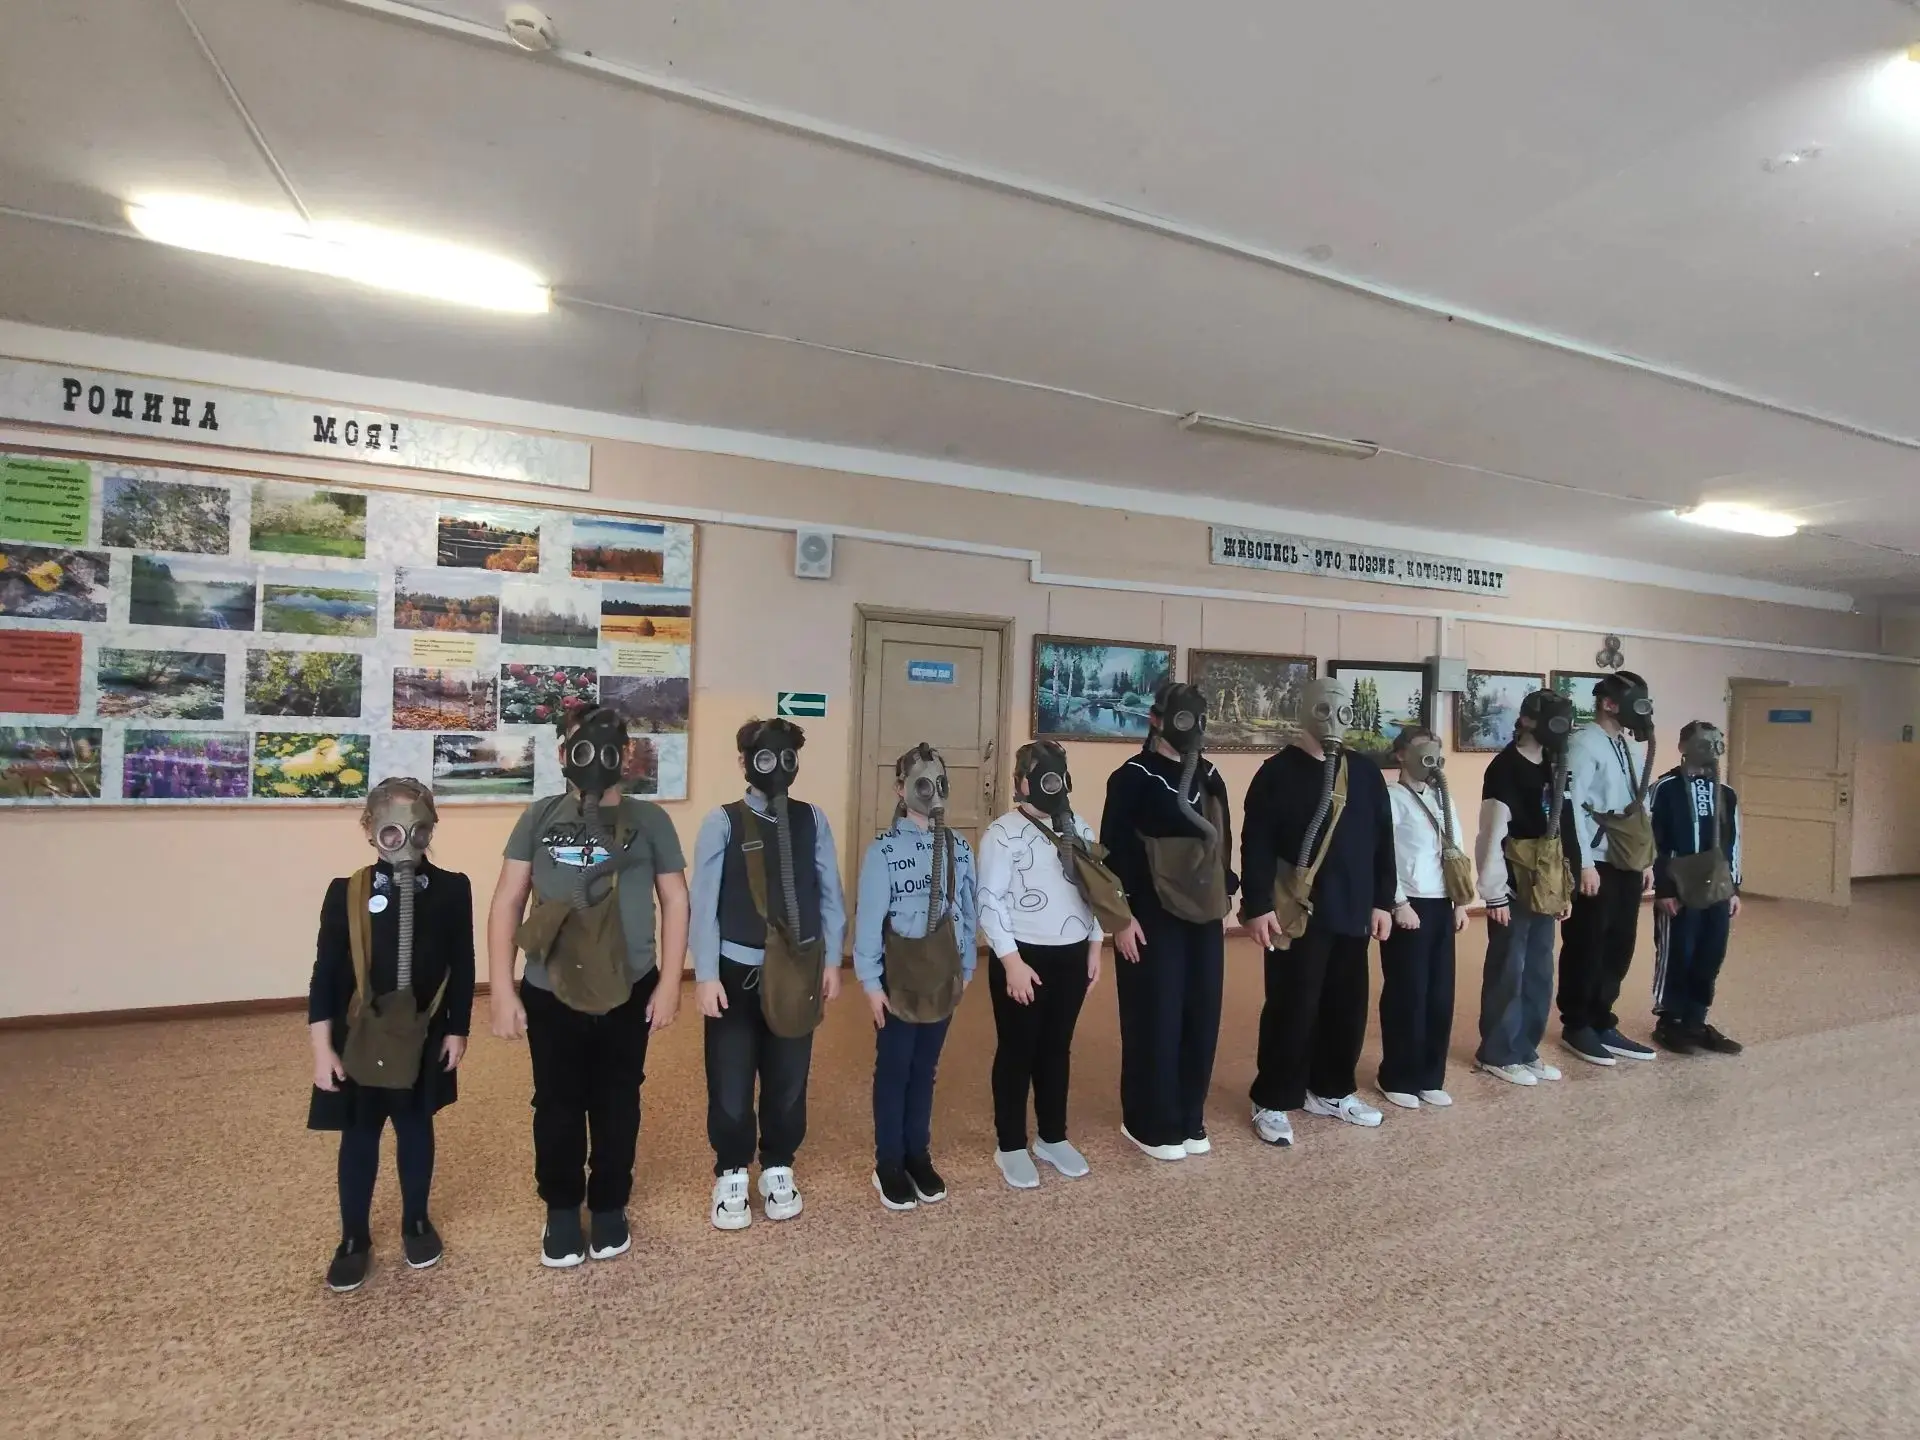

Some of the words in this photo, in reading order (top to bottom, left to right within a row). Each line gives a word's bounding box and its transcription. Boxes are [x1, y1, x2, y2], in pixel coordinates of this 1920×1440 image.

[62, 377, 219, 431] РОДИНА
[313, 415, 399, 452] МОЯ!
[1223, 537, 1298, 564] ЖИВОПИСЬ
[1315, 549, 1341, 570] ЭТО
[1406, 560, 1462, 583] КОТОРУЮ
[1467, 568, 1503, 589] ВИДЯТ
[894, 874, 932, 894] LOUIS
